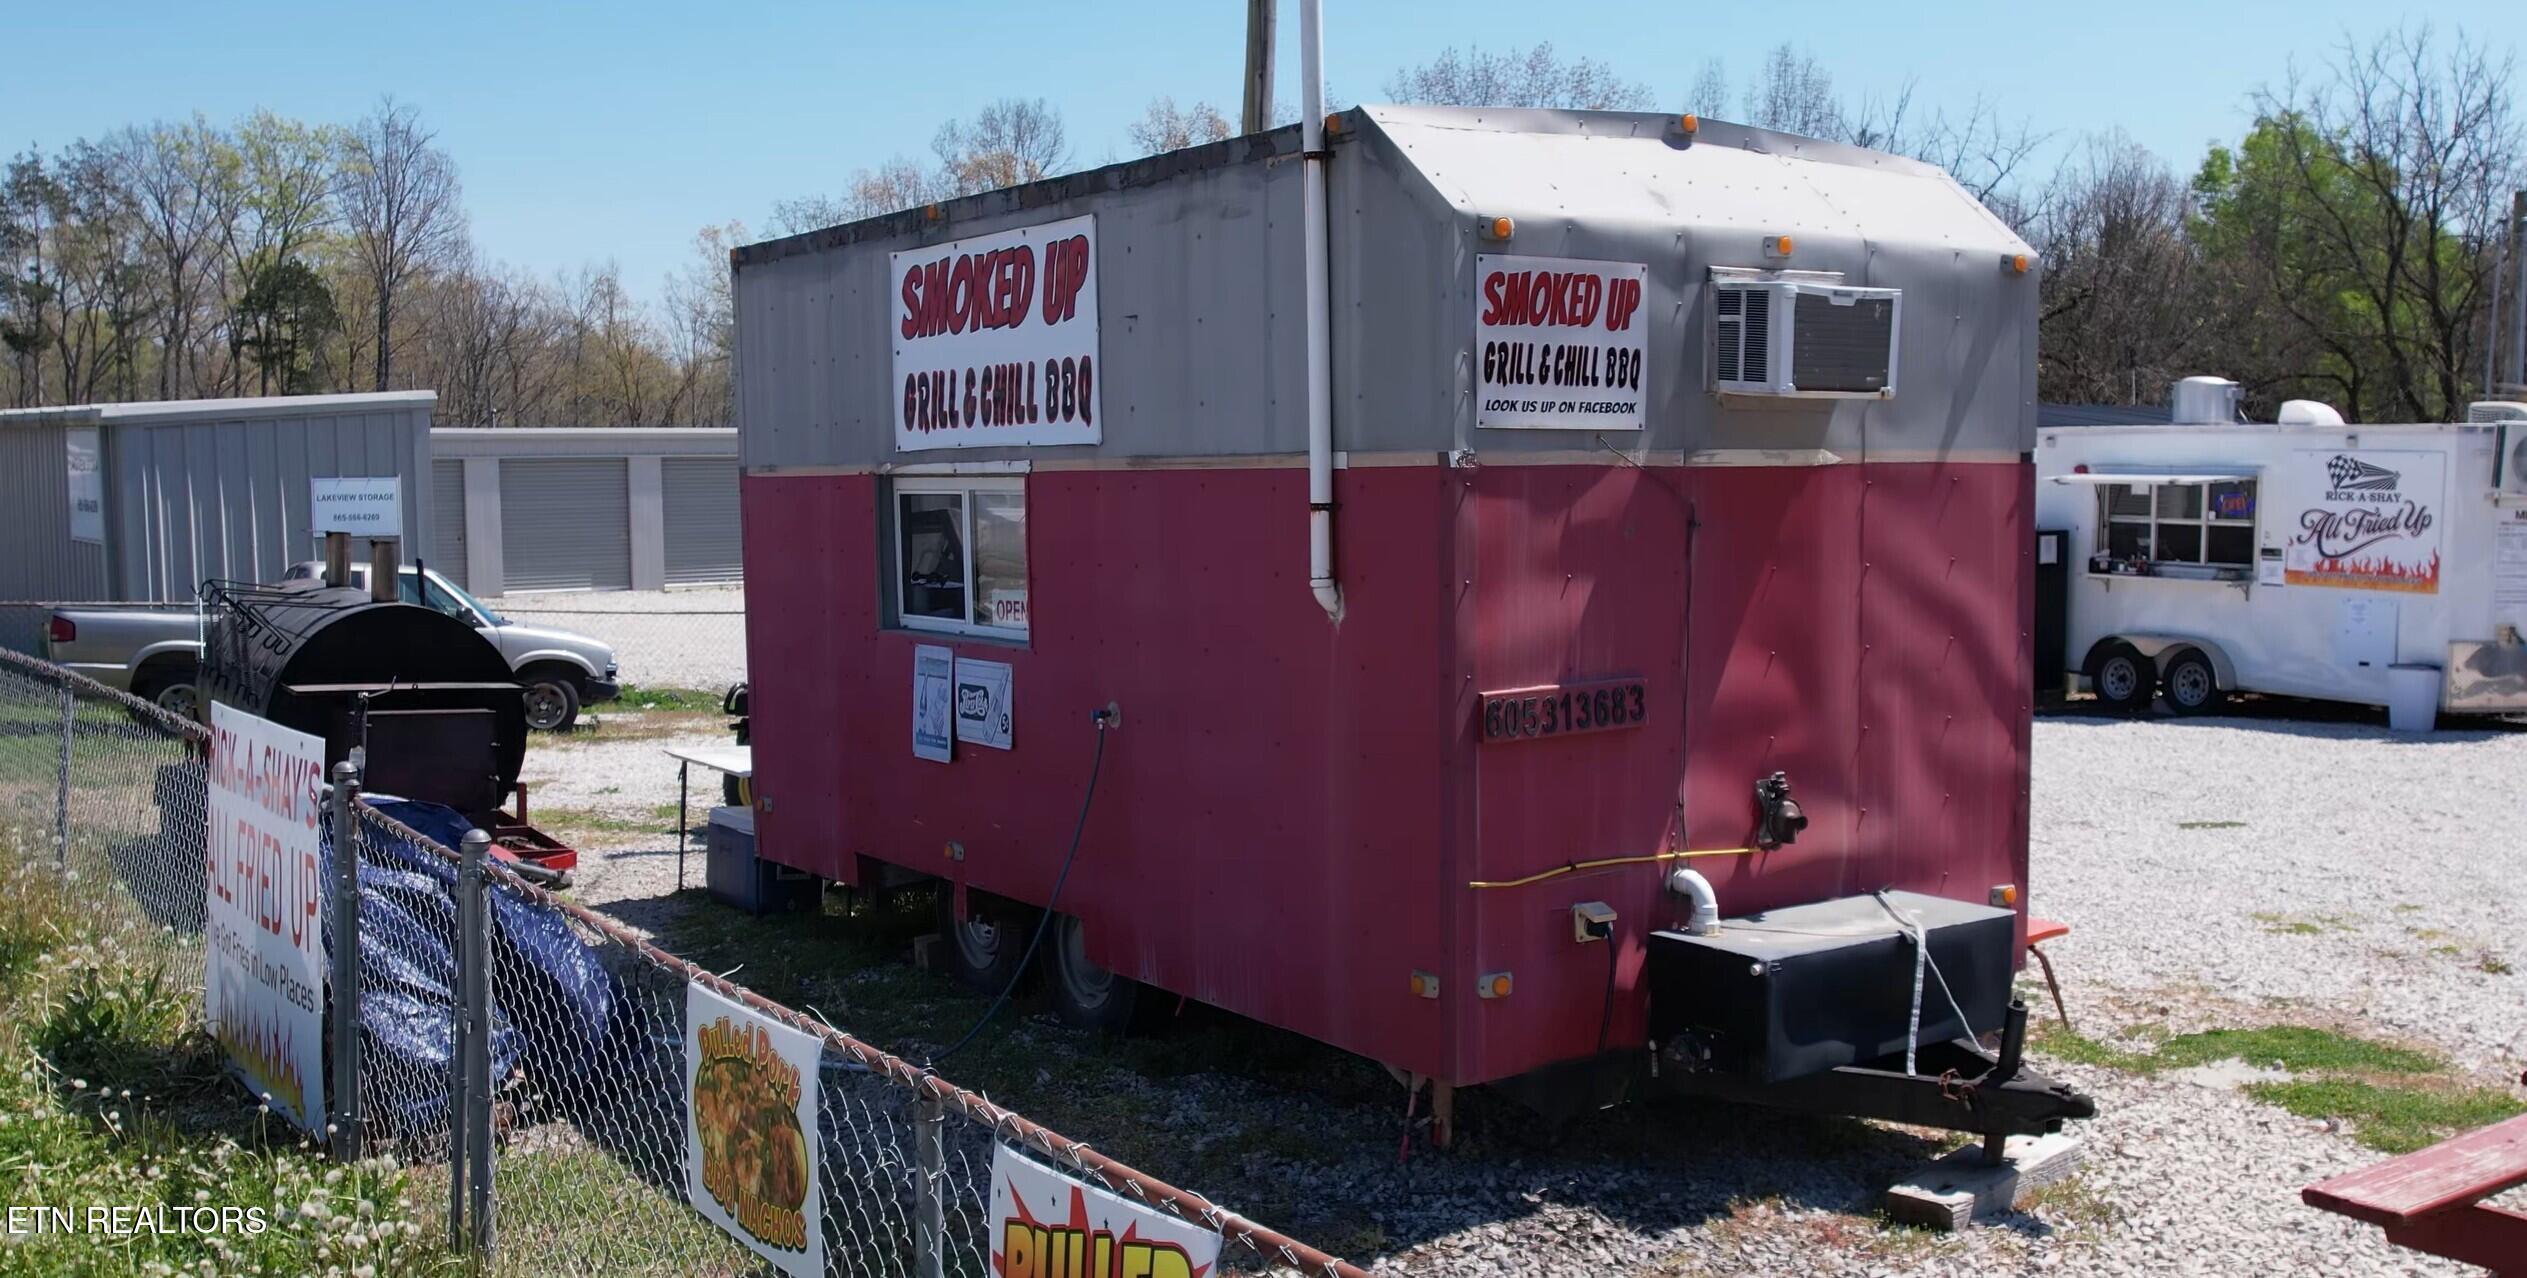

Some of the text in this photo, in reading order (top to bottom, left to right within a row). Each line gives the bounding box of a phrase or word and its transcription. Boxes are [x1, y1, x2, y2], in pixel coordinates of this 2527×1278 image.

[901, 234, 1090, 340] SMOKED UP
[1482, 271, 1642, 331] SMOKED UP
[904, 355, 1092, 435] GRILL & CHILL BBQ
[1484, 341, 1641, 393] GRILL & CHILL BBQ
[1485, 399, 1637, 414] LOOK US UP ON FACEBOOK
[316, 492, 394, 502] LAKEVIEW STORAGE
[2297, 508, 2344, 546] All
[2403, 499, 2433, 538] Up
[996, 600, 1028, 622] OPEN
[1485, 685, 1646, 737] 605313683
[208, 803, 317, 953] ALL FRIED UP
[250, 945, 259, 979] in
[259, 950, 278, 993] Low
[279, 963, 314, 1014] Places
[697, 1016, 802, 1115] Pulled Pork
[702, 1147, 807, 1254] BBQ NACHOS
